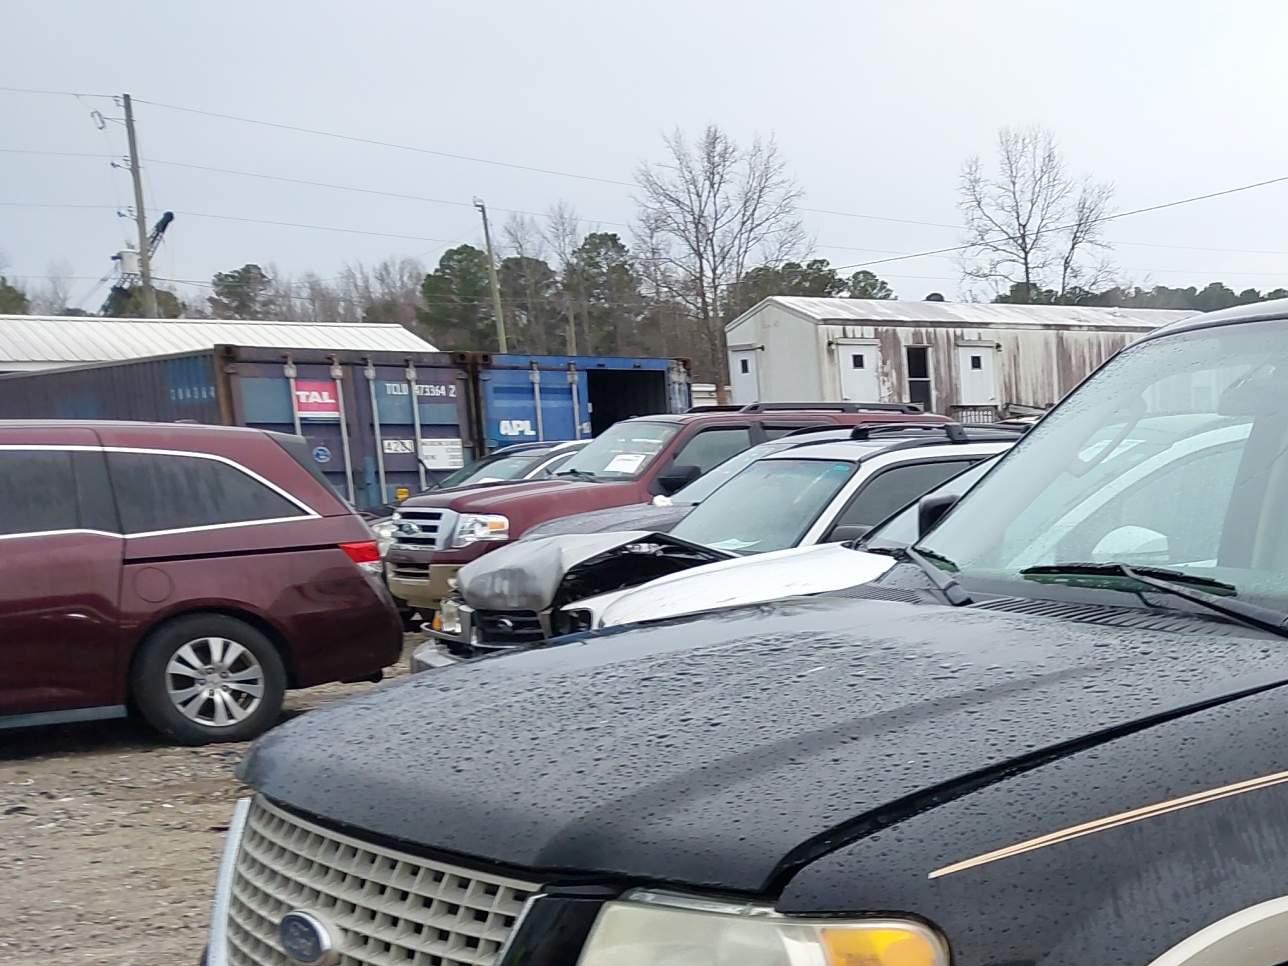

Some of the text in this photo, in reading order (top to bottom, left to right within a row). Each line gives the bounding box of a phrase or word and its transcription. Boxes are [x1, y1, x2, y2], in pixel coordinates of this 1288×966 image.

[295, 391, 336, 403] TAL
[448, 384, 457, 398] 2
[499, 419, 537, 436] APL
